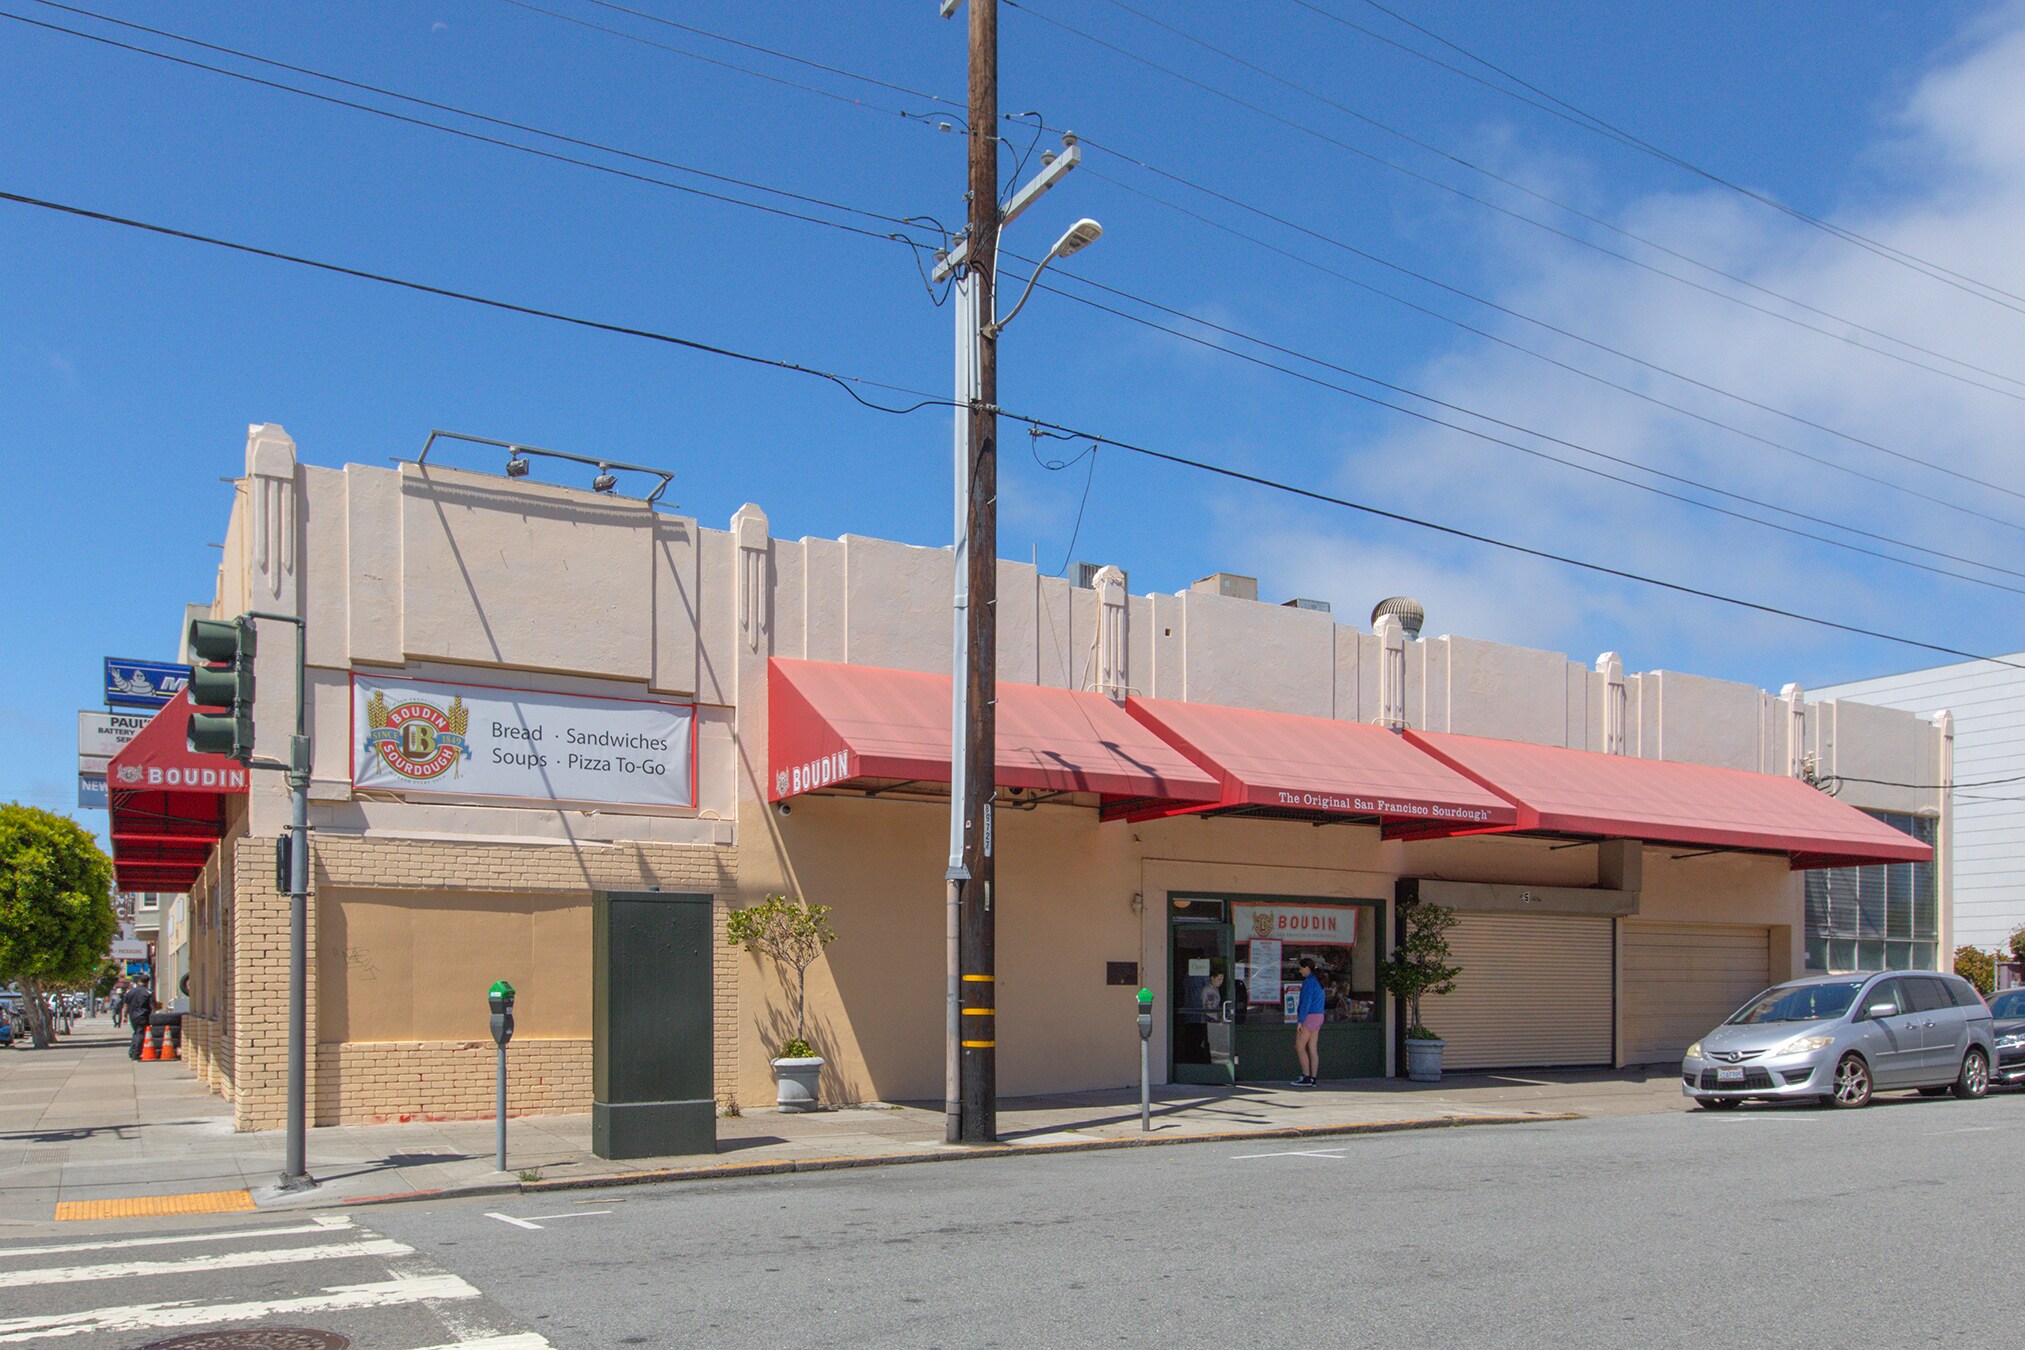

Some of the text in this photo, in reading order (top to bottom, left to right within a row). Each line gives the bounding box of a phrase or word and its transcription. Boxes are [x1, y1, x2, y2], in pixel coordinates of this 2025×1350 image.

[391, 706, 446, 728] BOUDIN
[98, 728, 135, 736] BATTERY
[373, 731, 399, 740] SINCE
[442, 735, 461, 745] 1849
[492, 721, 668, 751] Bread Sandwiches
[384, 744, 453, 775] SOURDOUGH
[492, 747, 666, 775] Soups Pizza To-Go
[148, 767, 245, 787] BOUDIN
[793, 749, 848, 794] BOUDIN
[1278, 791, 1488, 821] The Original San Francisco Sourdough
[1278, 915, 1337, 931] BOUDIN
